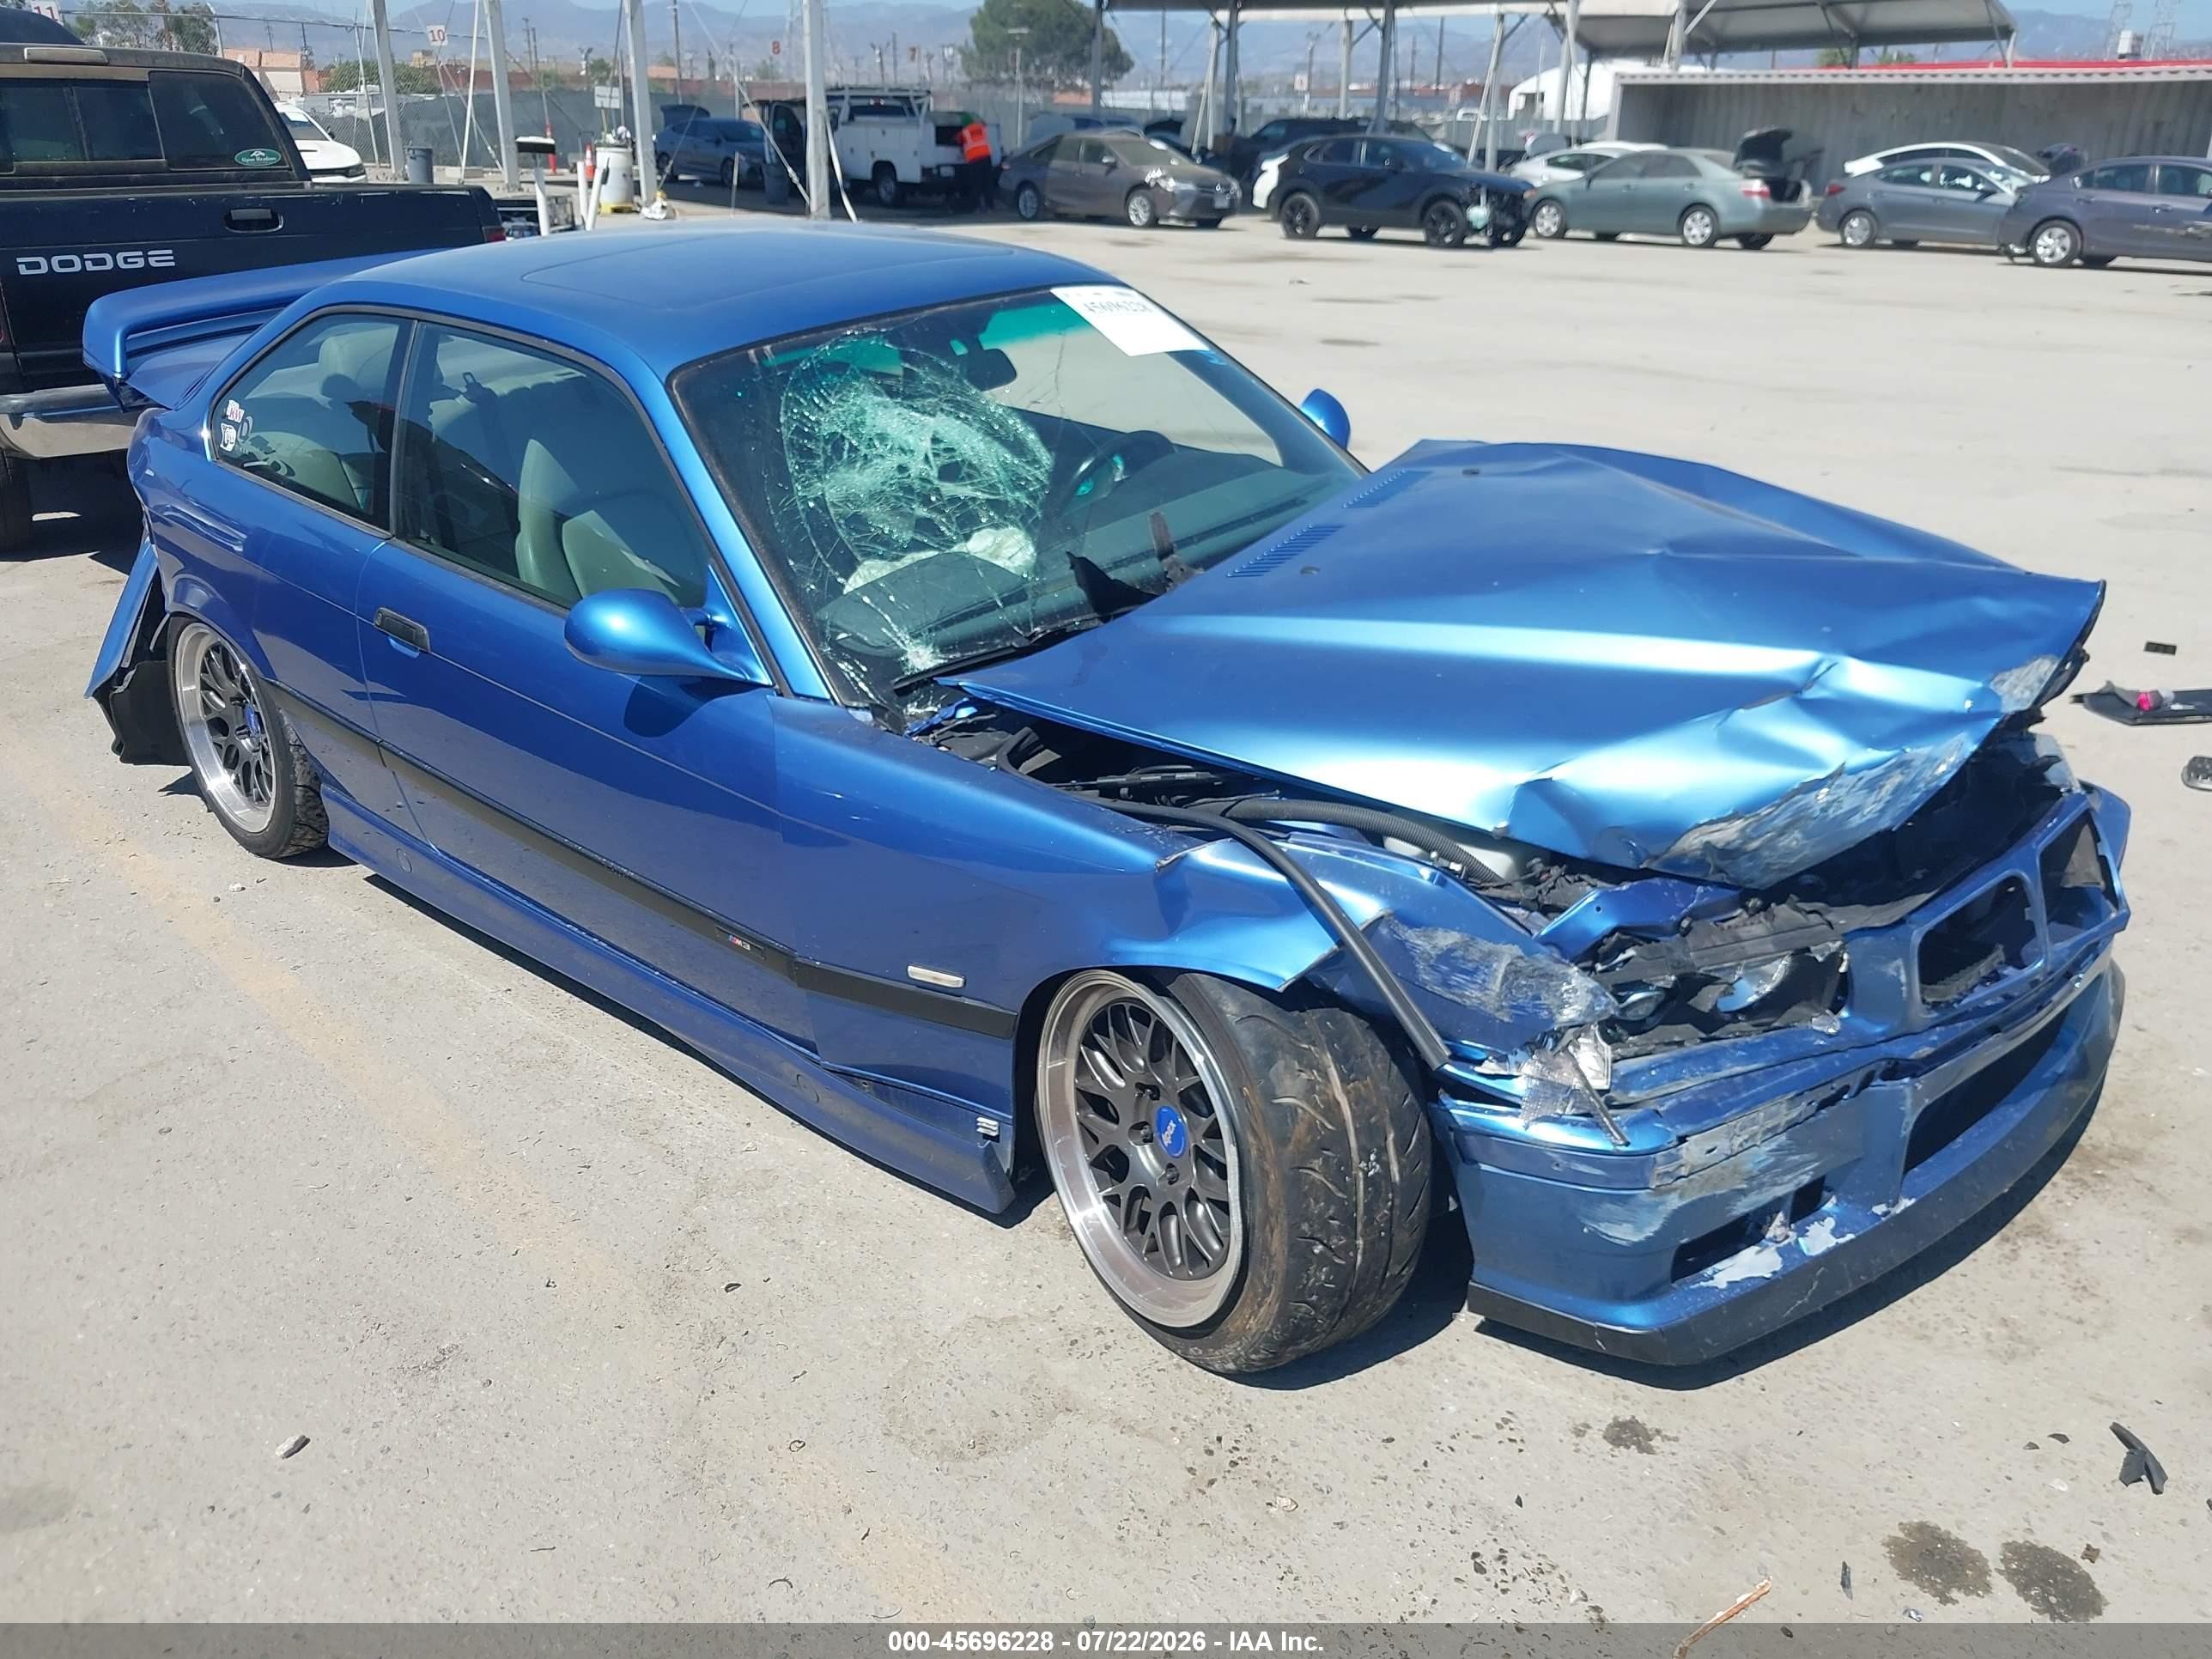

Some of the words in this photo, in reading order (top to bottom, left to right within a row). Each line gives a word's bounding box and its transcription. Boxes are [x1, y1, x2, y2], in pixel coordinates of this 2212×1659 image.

[429, 29, 445, 41] 10
[772, 40, 781, 55] 8
[16, 249, 175, 275] DODGE
